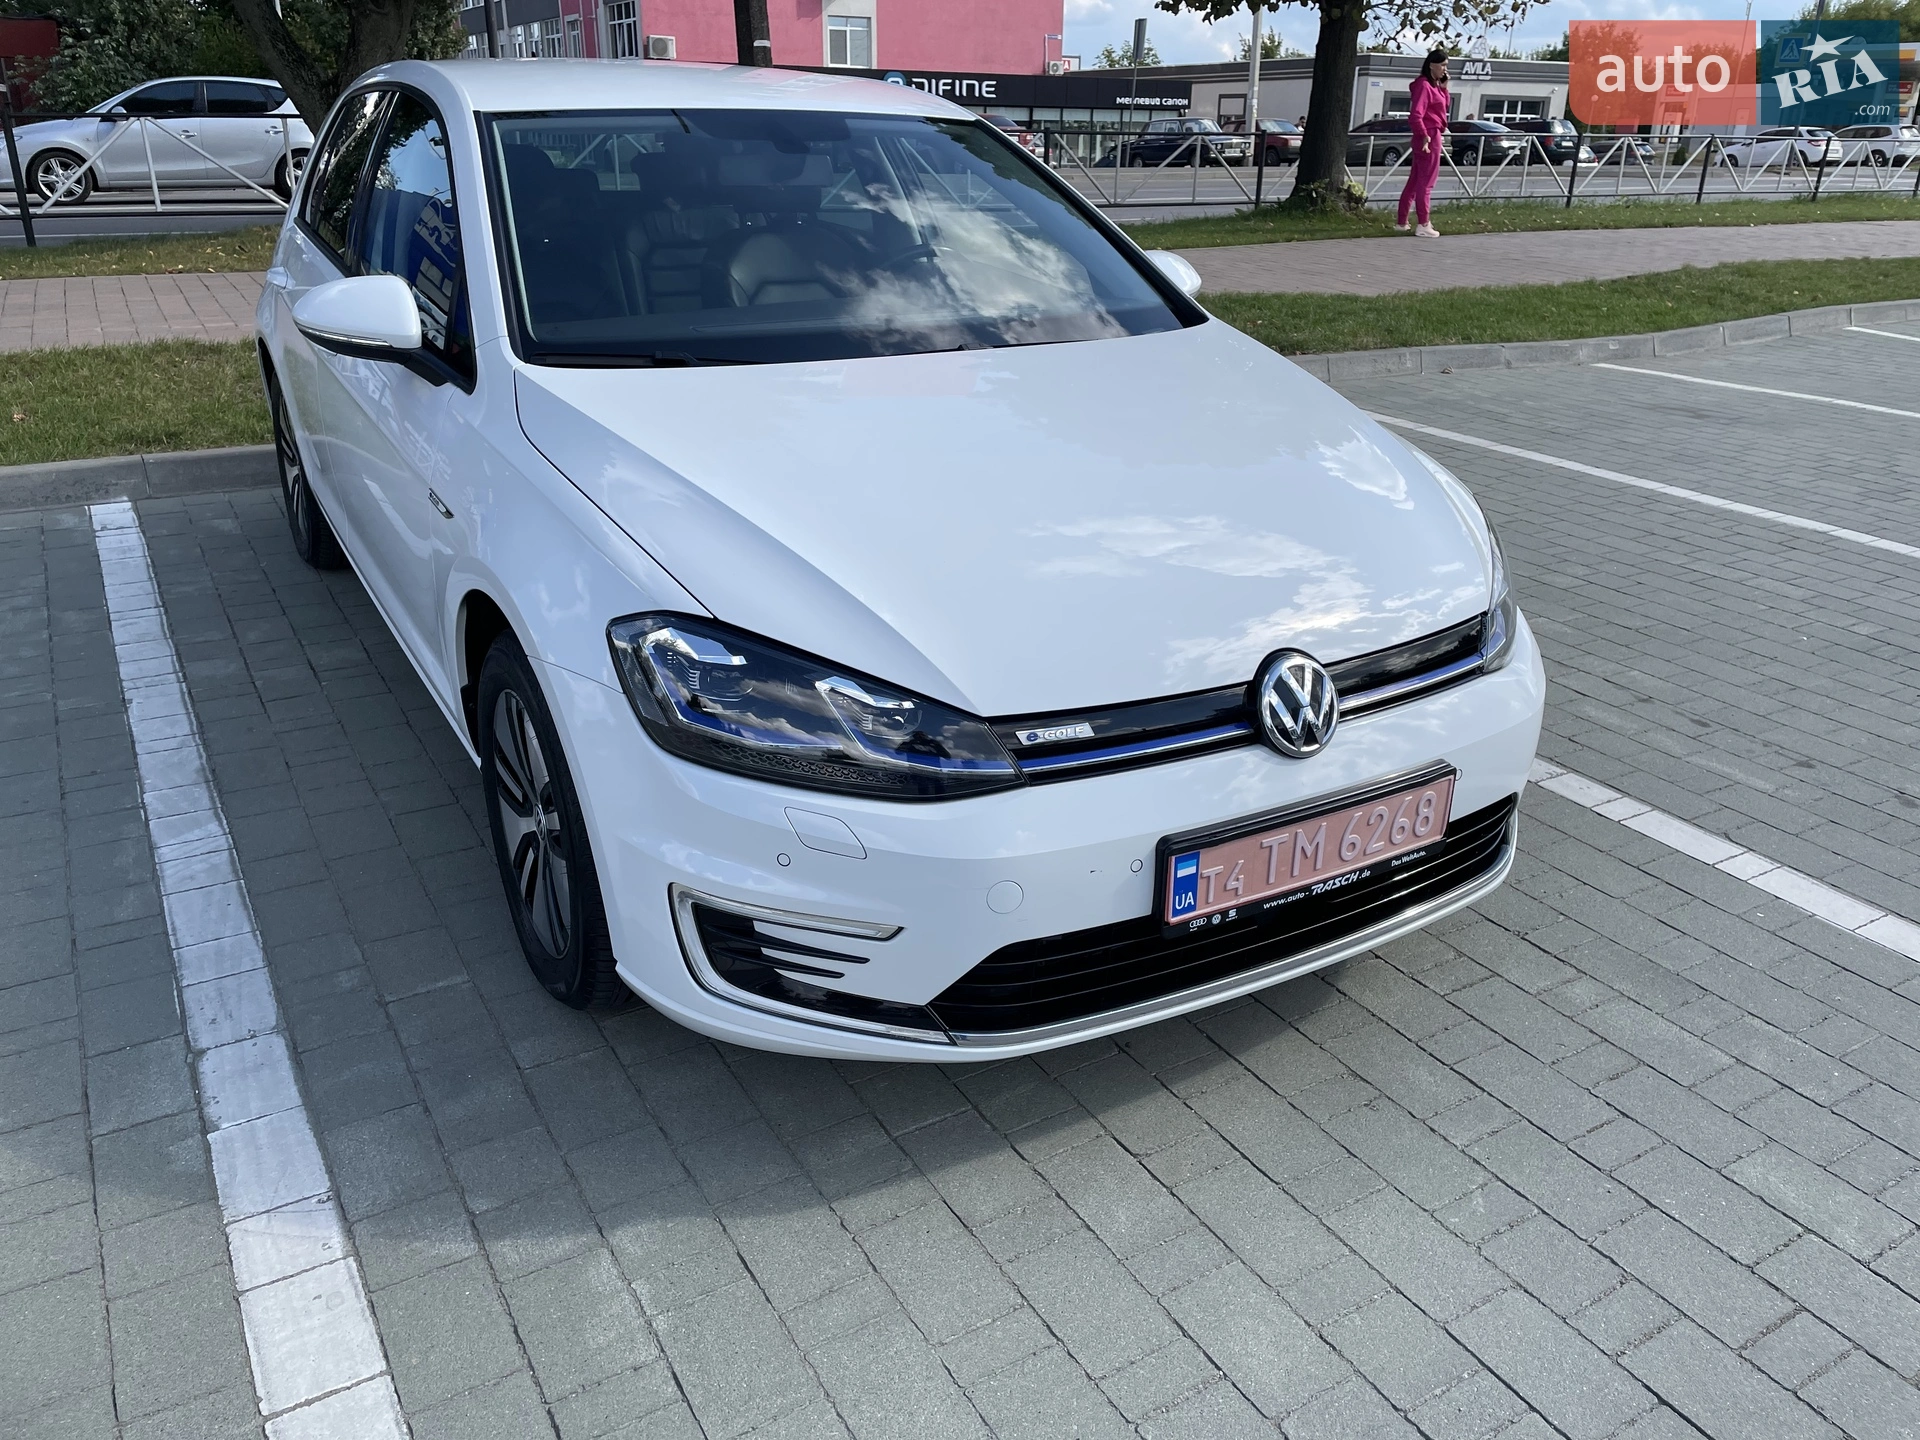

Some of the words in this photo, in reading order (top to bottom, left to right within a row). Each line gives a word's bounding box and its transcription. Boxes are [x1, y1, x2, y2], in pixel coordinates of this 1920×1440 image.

[1462, 61, 1492, 75] AVILA
[1201, 860, 1245, 904] T4
[1261, 822, 1328, 885] TM
[1339, 791, 1437, 863] 6268
[1175, 891, 1195, 910] UA
